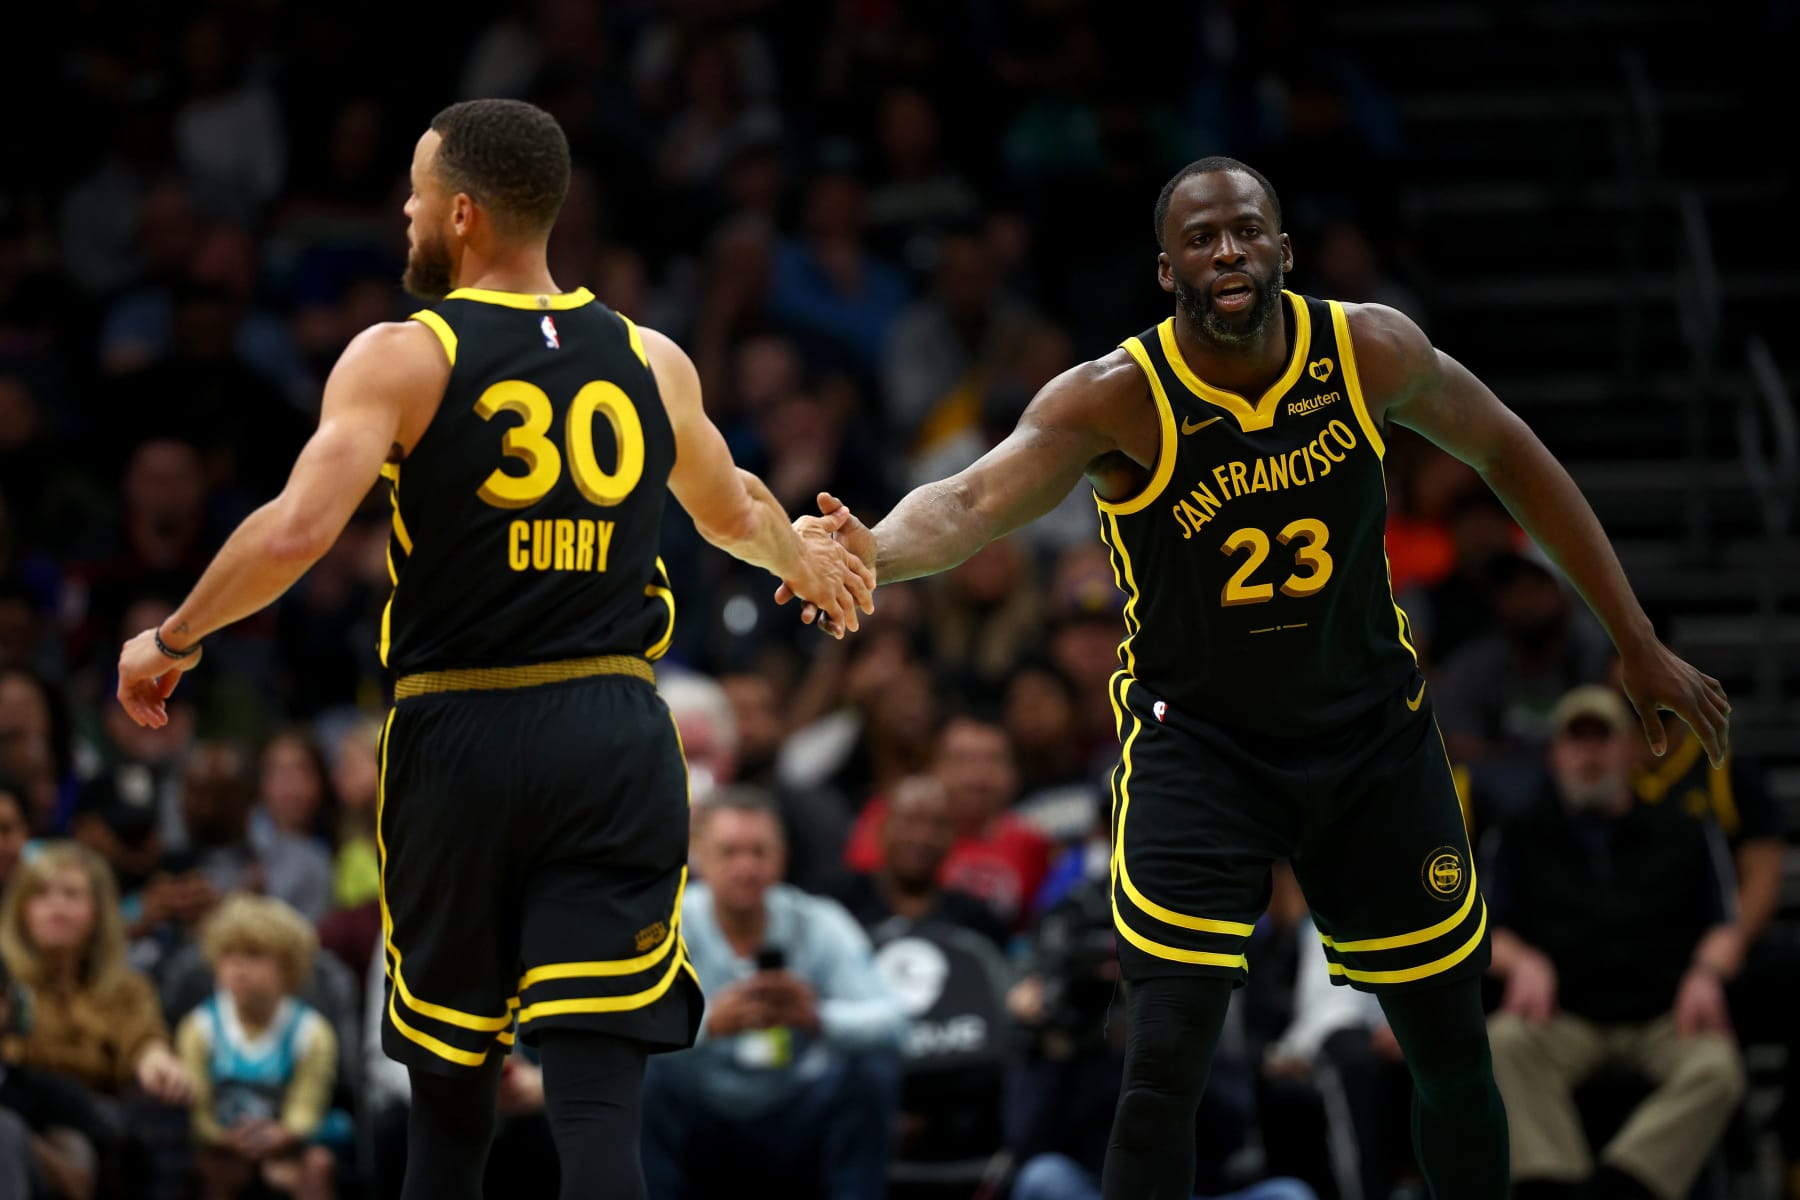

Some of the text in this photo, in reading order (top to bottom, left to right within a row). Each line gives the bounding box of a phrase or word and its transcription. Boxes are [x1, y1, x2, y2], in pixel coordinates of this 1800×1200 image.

[473, 379, 645, 509] 30
[1288, 391, 1341, 416] Rakuten
[1172, 419, 1357, 540] SAN FRANCISCO
[508, 519, 615, 572] CURRY
[1220, 518, 1334, 608] 23
